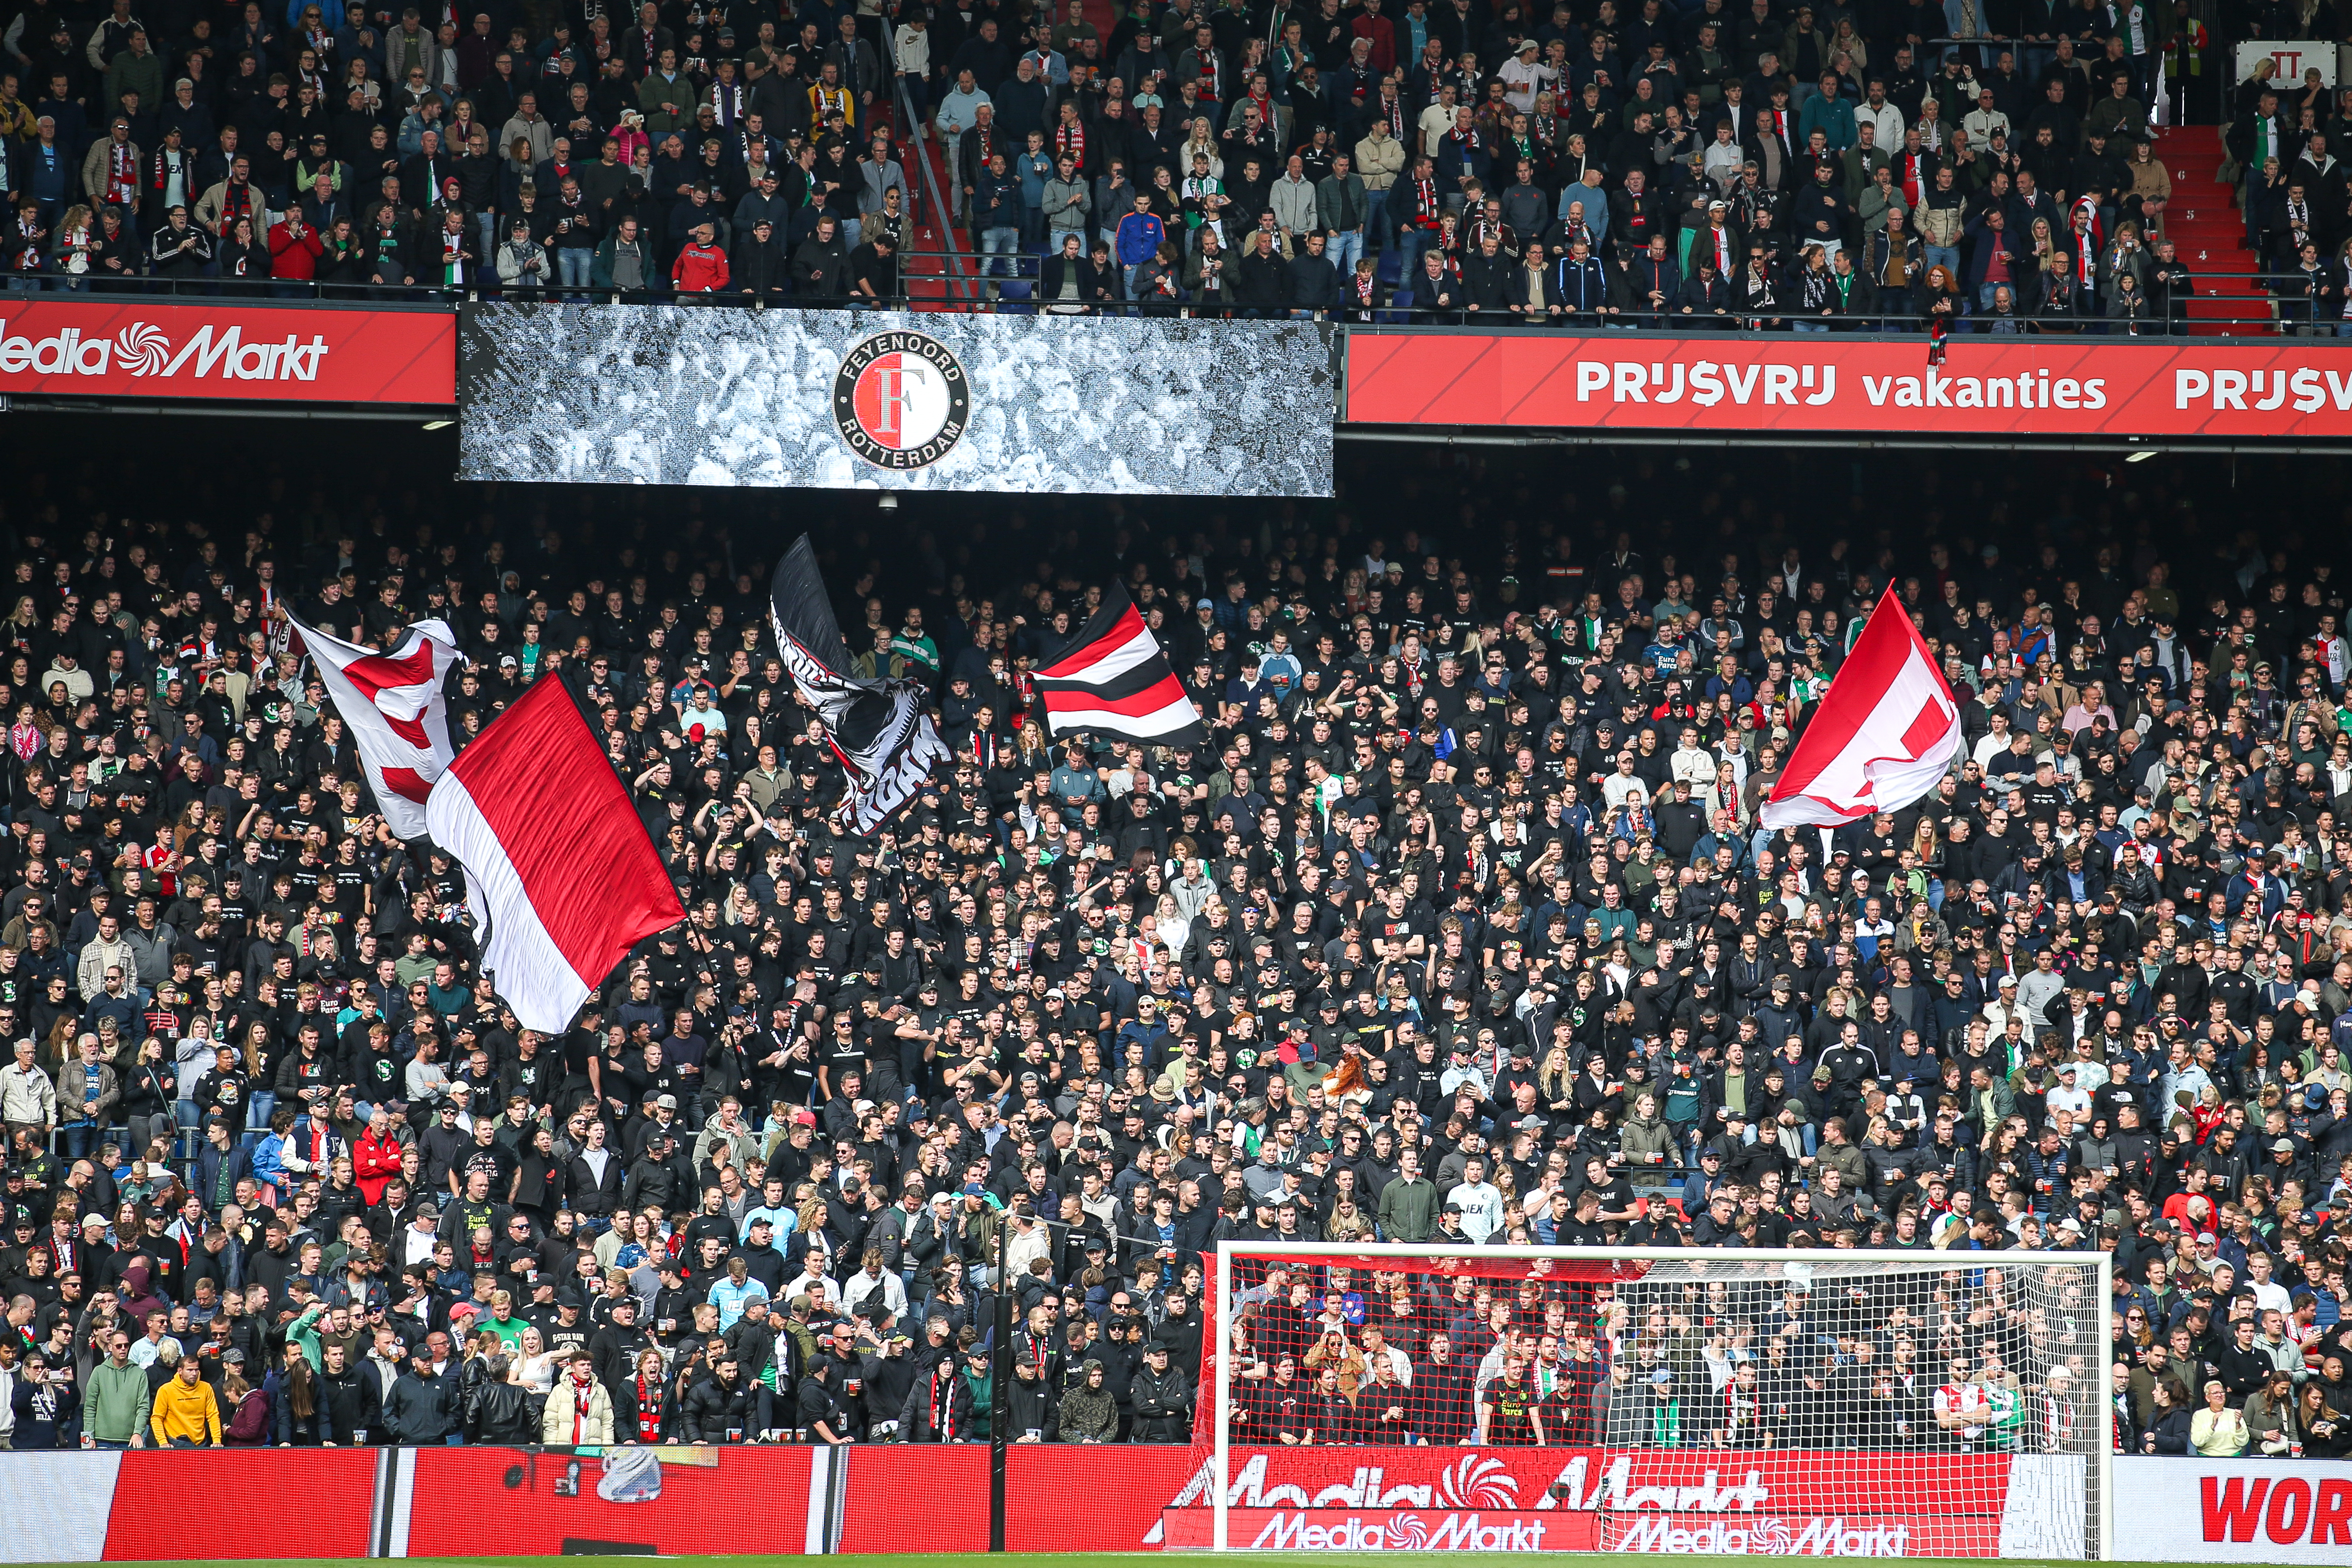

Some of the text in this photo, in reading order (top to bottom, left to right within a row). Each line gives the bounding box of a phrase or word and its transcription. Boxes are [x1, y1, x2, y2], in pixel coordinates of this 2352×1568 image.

[2164, 127, 2170, 136] 7
[2178, 170, 2186, 181] 6
[2186, 210, 2195, 220] 5
[924, 229, 932, 239] 4
[2198, 250, 2207, 261] 4
[0, 319, 329, 381] edia Markt
[842, 334, 960, 381] FEYENOORD
[874, 368, 925, 433] F
[1862, 369, 2106, 409] vakanties
[842, 418, 961, 466] ROTTERDAM
[552, 1333, 584, 1343] G-STAR RAW
[1502, 1407, 1523, 1416] Parcs
[639, 1420, 650, 1432] 12
[2201, 1476, 2352, 1545] WOR
[1250, 1511, 1546, 1551] Media Markt
[1615, 1515, 1909, 1557] Media Markt
